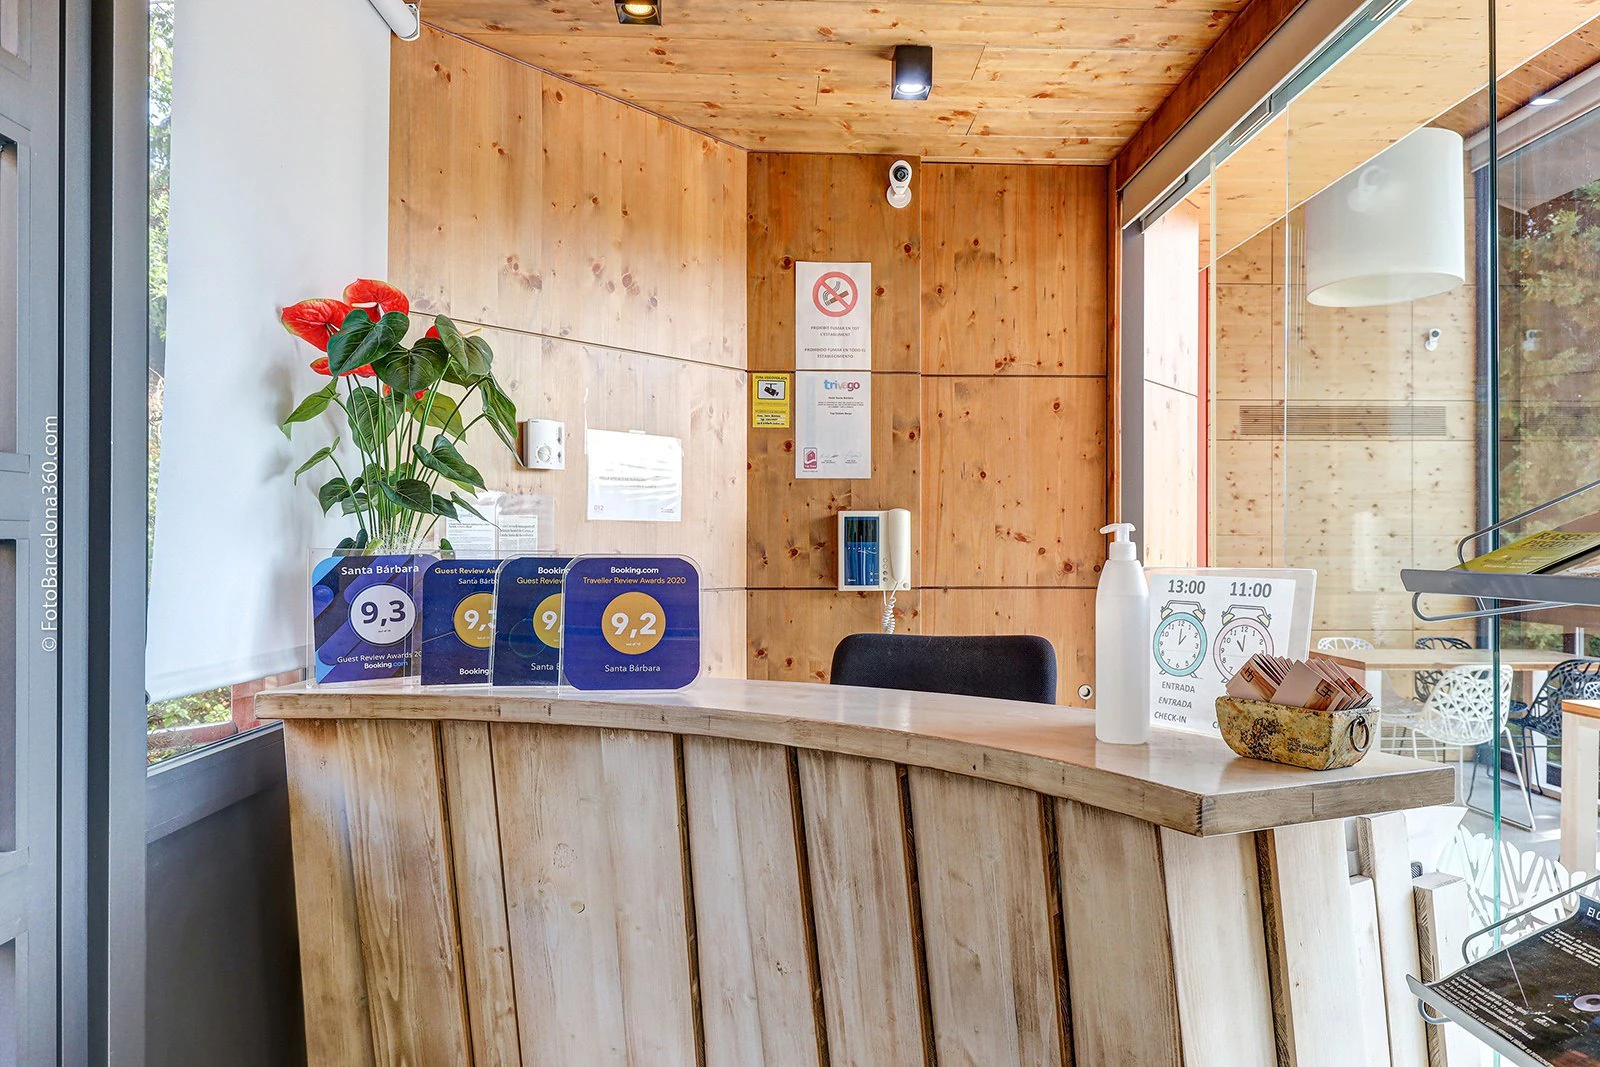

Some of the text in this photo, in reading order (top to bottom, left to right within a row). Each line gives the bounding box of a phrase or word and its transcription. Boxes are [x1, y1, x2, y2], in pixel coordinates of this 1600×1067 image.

[824, 379, 860, 391] trivago
[341, 564, 419, 575] Santa Bárbara
[610, 567, 659, 576] Booking.com
[1167, 579, 1272, 598] 13:00 11:00
[360, 600, 406, 627] 9,3
[611, 612, 657, 639] 9,2
[337, 655, 359, 663] Guest
[364, 660, 408, 670] Booking.com
[531, 663, 553, 671] Santa
[605, 664, 660, 672] Santa Bárbara
[1161, 681, 1195, 693] ENTRADA
[1158, 697, 1192, 708] ENTRADA
[1154, 711, 1187, 724] CHECK-IN
